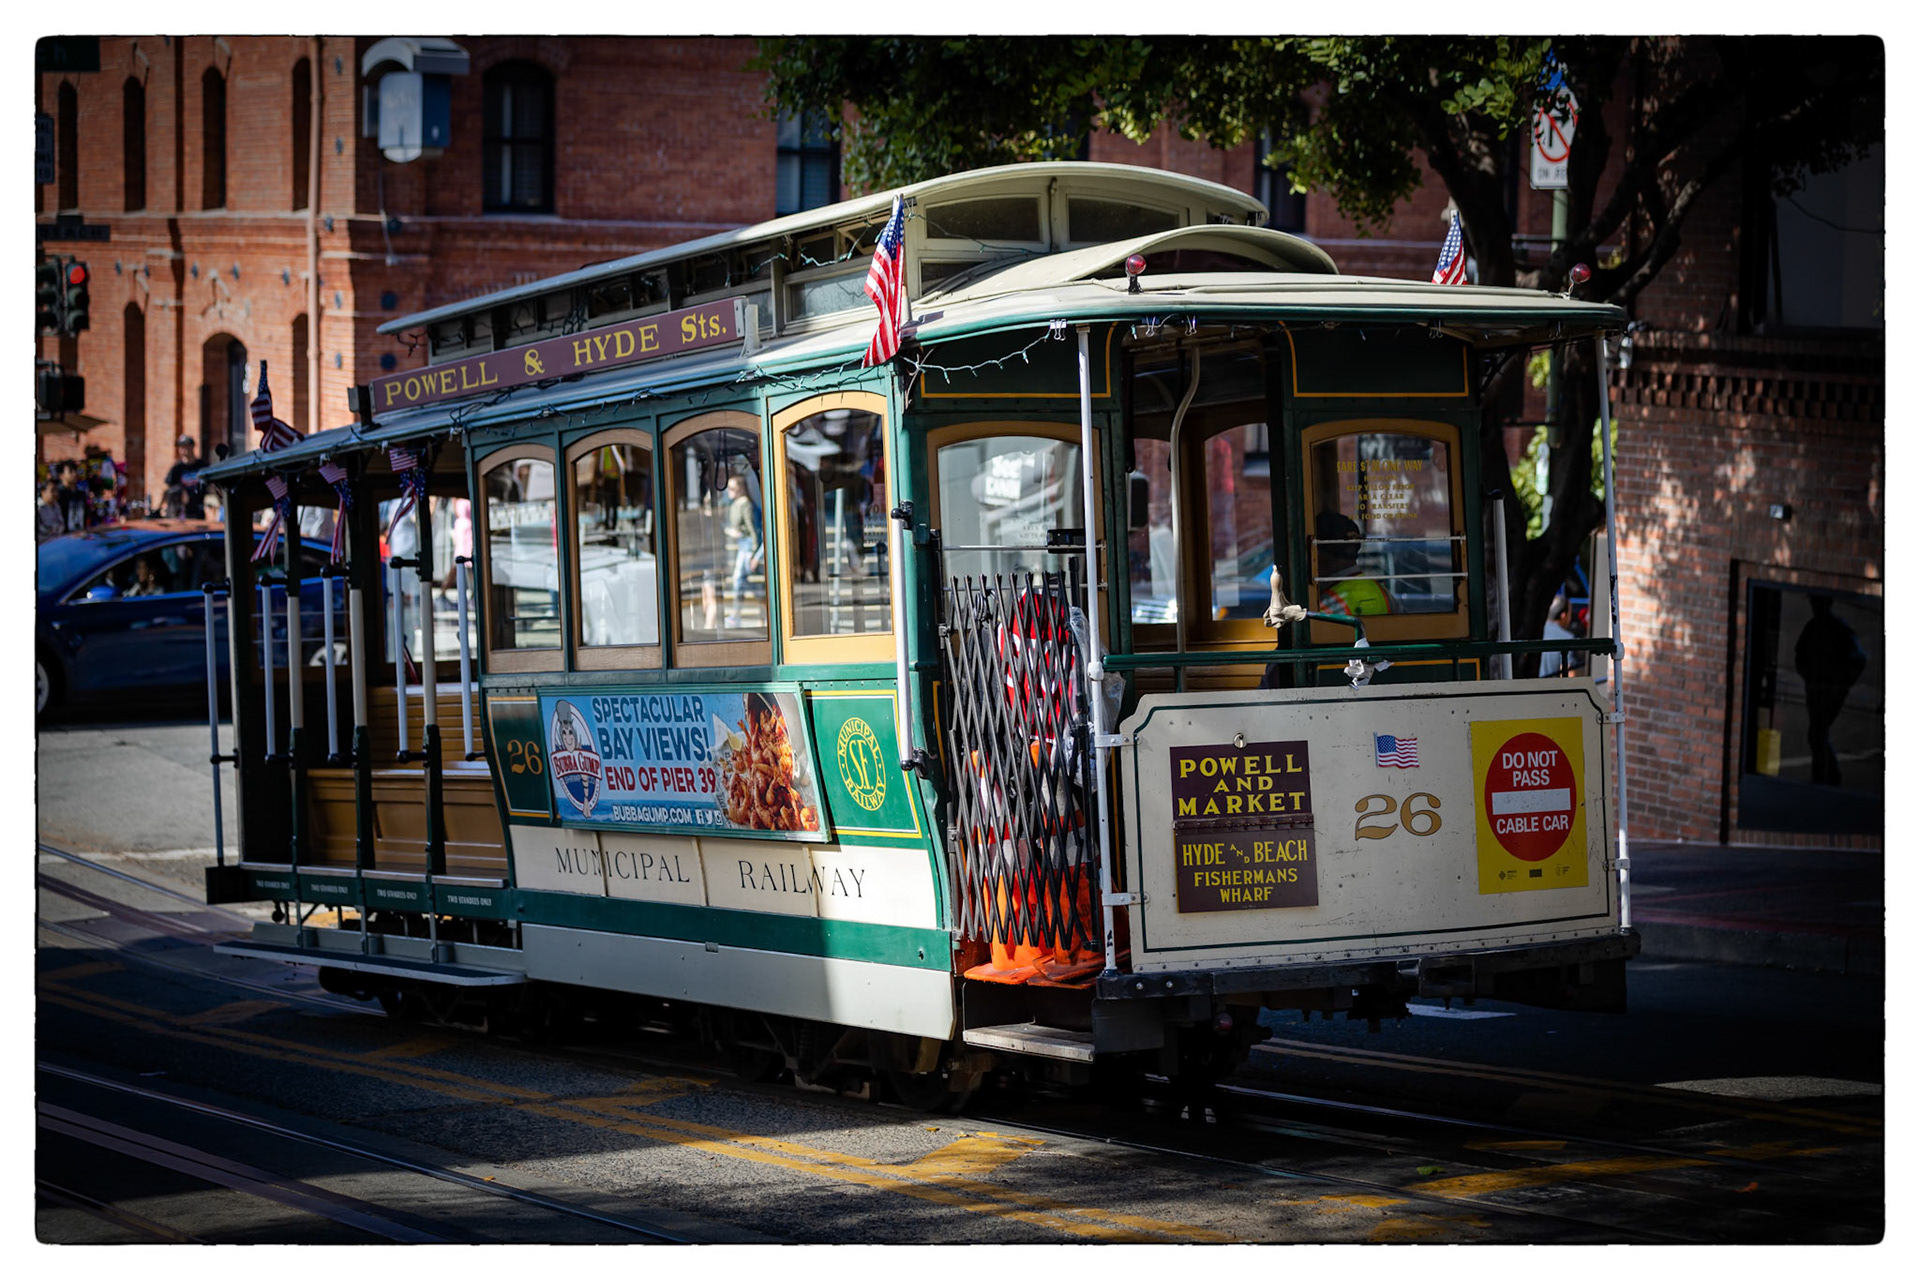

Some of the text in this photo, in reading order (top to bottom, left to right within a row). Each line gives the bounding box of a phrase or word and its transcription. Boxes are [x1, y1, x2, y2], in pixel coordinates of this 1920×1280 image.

[384, 312, 728, 407] POWELL & HYDE Sts.
[1404, 459, 1424, 472] WAY
[592, 696, 706, 723] SPECTACULAR
[597, 727, 634, 760] BAY
[636, 727, 712, 761] VIEWS!
[839, 720, 880, 760] MUNICIPAL
[507, 739, 543, 775] 26
[553, 752, 600, 775] BUBBA GUMP
[1179, 754, 1303, 778] POWELL
[1502, 750, 1558, 769] DO NOT
[604, 766, 717, 794] END OF PIER 39
[1213, 776, 1274, 793] AND
[1512, 769, 1550, 787] PASS
[845, 777, 885, 809] RAILWAY
[1178, 792, 1306, 817] MARKET
[612, 805, 693, 824] BUBBAGUMP.COM
[1354, 791, 1443, 841] 26
[1496, 814, 1569, 834] CABLE CAR
[1182, 843, 1226, 866] HYDE
[1253, 839, 1308, 863] BEACH
[555, 847, 866, 898] MUNICIPAL RAILWAY
[1194, 868, 1298, 887] FISHERMANS
[447, 895, 458, 903] TWO
[480, 897, 493, 906] ONLY
[1219, 886, 1274, 903] WHARF
